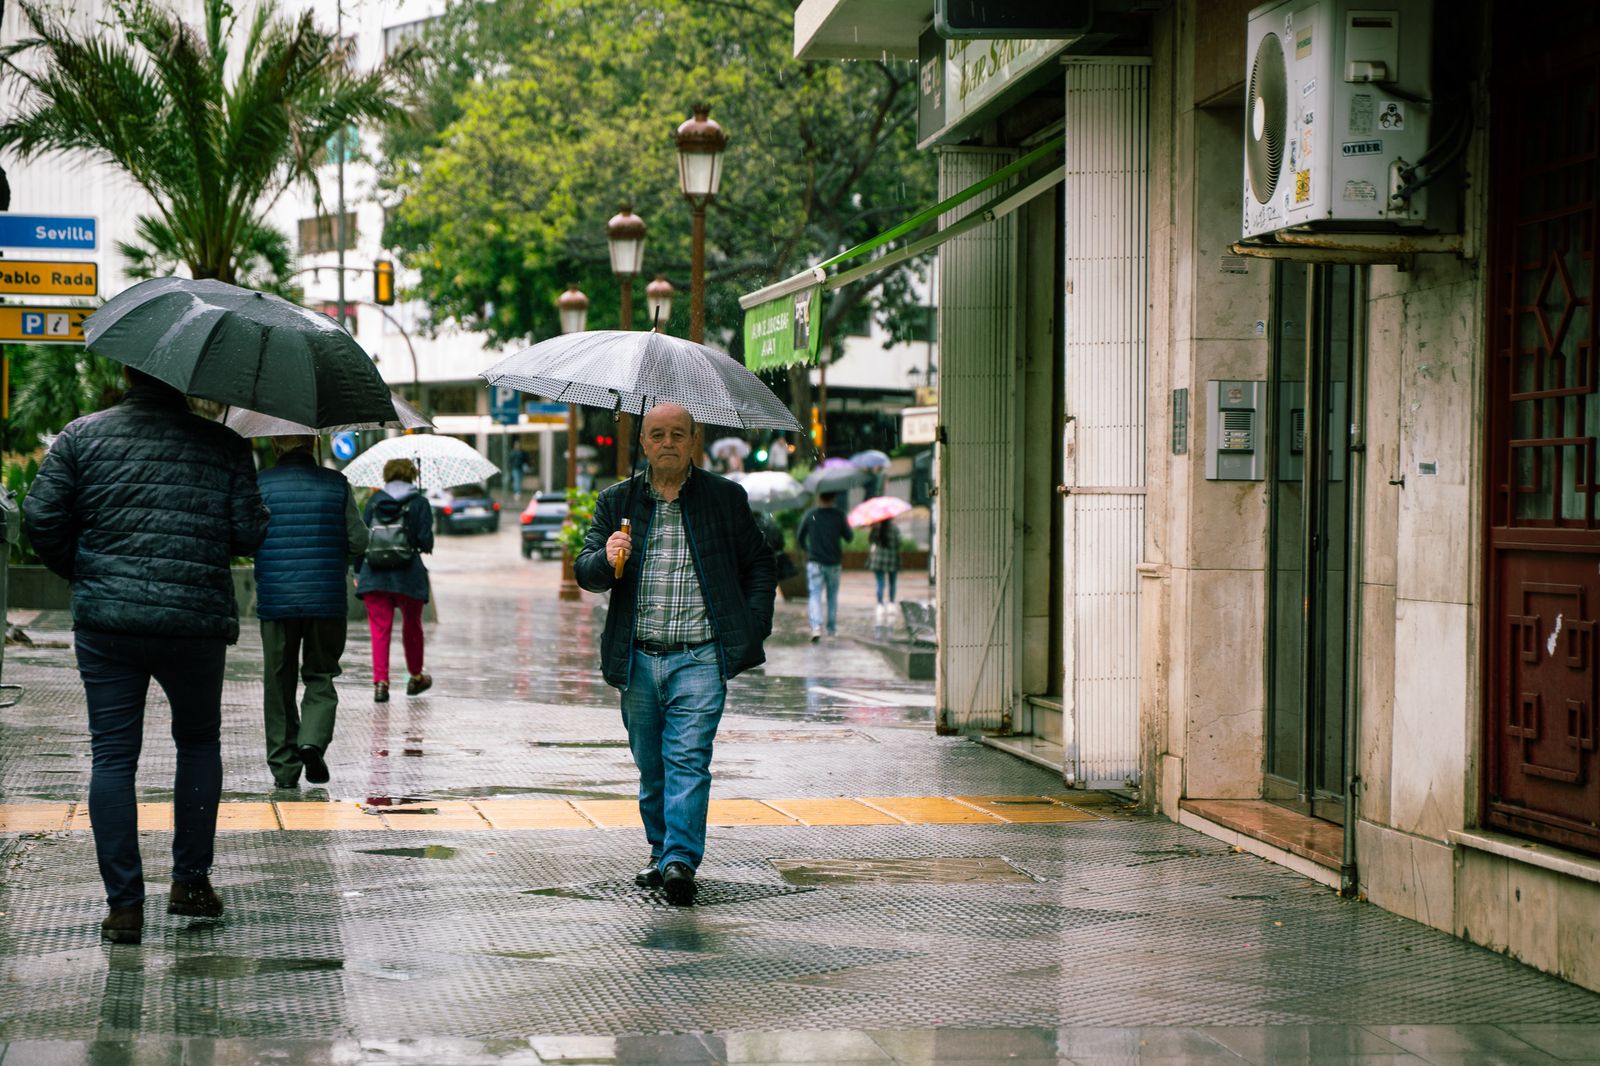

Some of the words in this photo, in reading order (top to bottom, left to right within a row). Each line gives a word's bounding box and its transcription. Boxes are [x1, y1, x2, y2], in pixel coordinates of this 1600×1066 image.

[1343, 143, 1381, 155] OTHER
[35, 225, 94, 241] Sevilla
[52, 272, 93, 286] Rada
[26, 314, 41, 333] P
